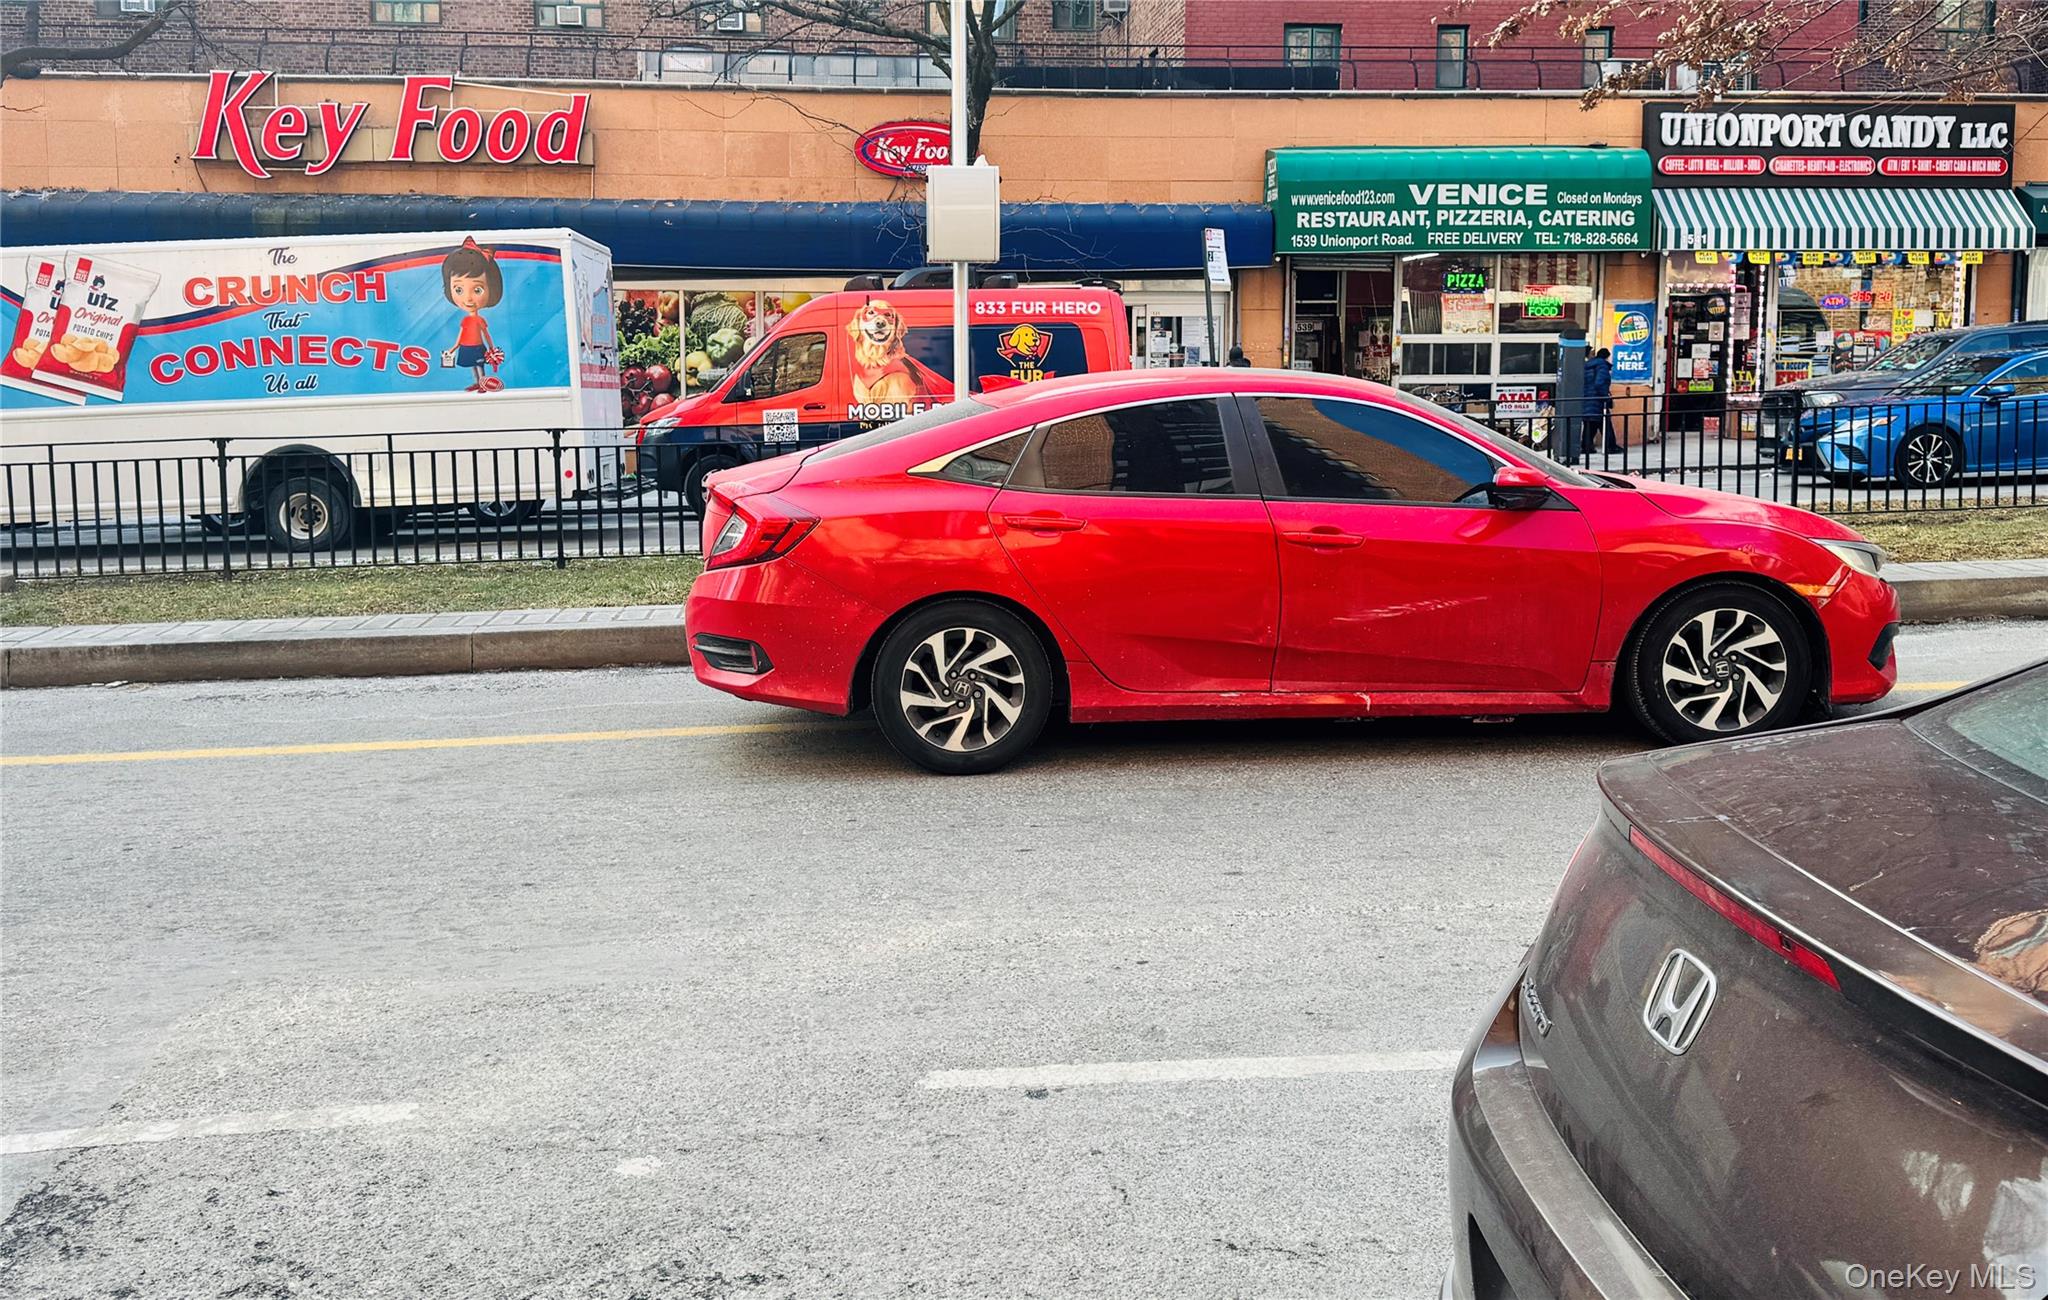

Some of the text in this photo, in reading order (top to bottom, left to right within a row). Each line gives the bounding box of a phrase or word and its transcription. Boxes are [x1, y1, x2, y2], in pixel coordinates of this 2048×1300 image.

[190, 70, 591, 179] Key Food
[1660, 112, 2008, 149] UNIONPORT CANDY LLC
[875, 137, 948, 164] Key Foo
[1291, 184, 1642, 207] www.venicefood123.com VENICE Closed on Mondays
[1297, 210, 1636, 229] RESTAURANT, PIZZERIA, CATERING
[1291, 232, 1638, 249] 1539 Unionport Road. FREE DELIVERY TEL: 718-828-5664
[268, 247, 297, 265] The
[182, 271, 388, 307] CRUNCH
[1447, 274, 1484, 288] PIZZA
[975, 301, 1101, 315] 833 FUR HERO
[1824, 297, 1845, 305] ATM
[74, 307, 123, 326] Original
[264, 311, 310, 330] That
[1528, 307, 1559, 317] FOOD
[149, 335, 431, 385] CONNECTS
[1617, 351, 1644, 361] PLAY
[1617, 362, 1648, 371] HERE.
[264, 374, 318, 393] Us all
[1010, 370, 1044, 383] FUR
[1498, 393, 1534, 403] ATM
[848, 403, 926, 419] MOBILE
